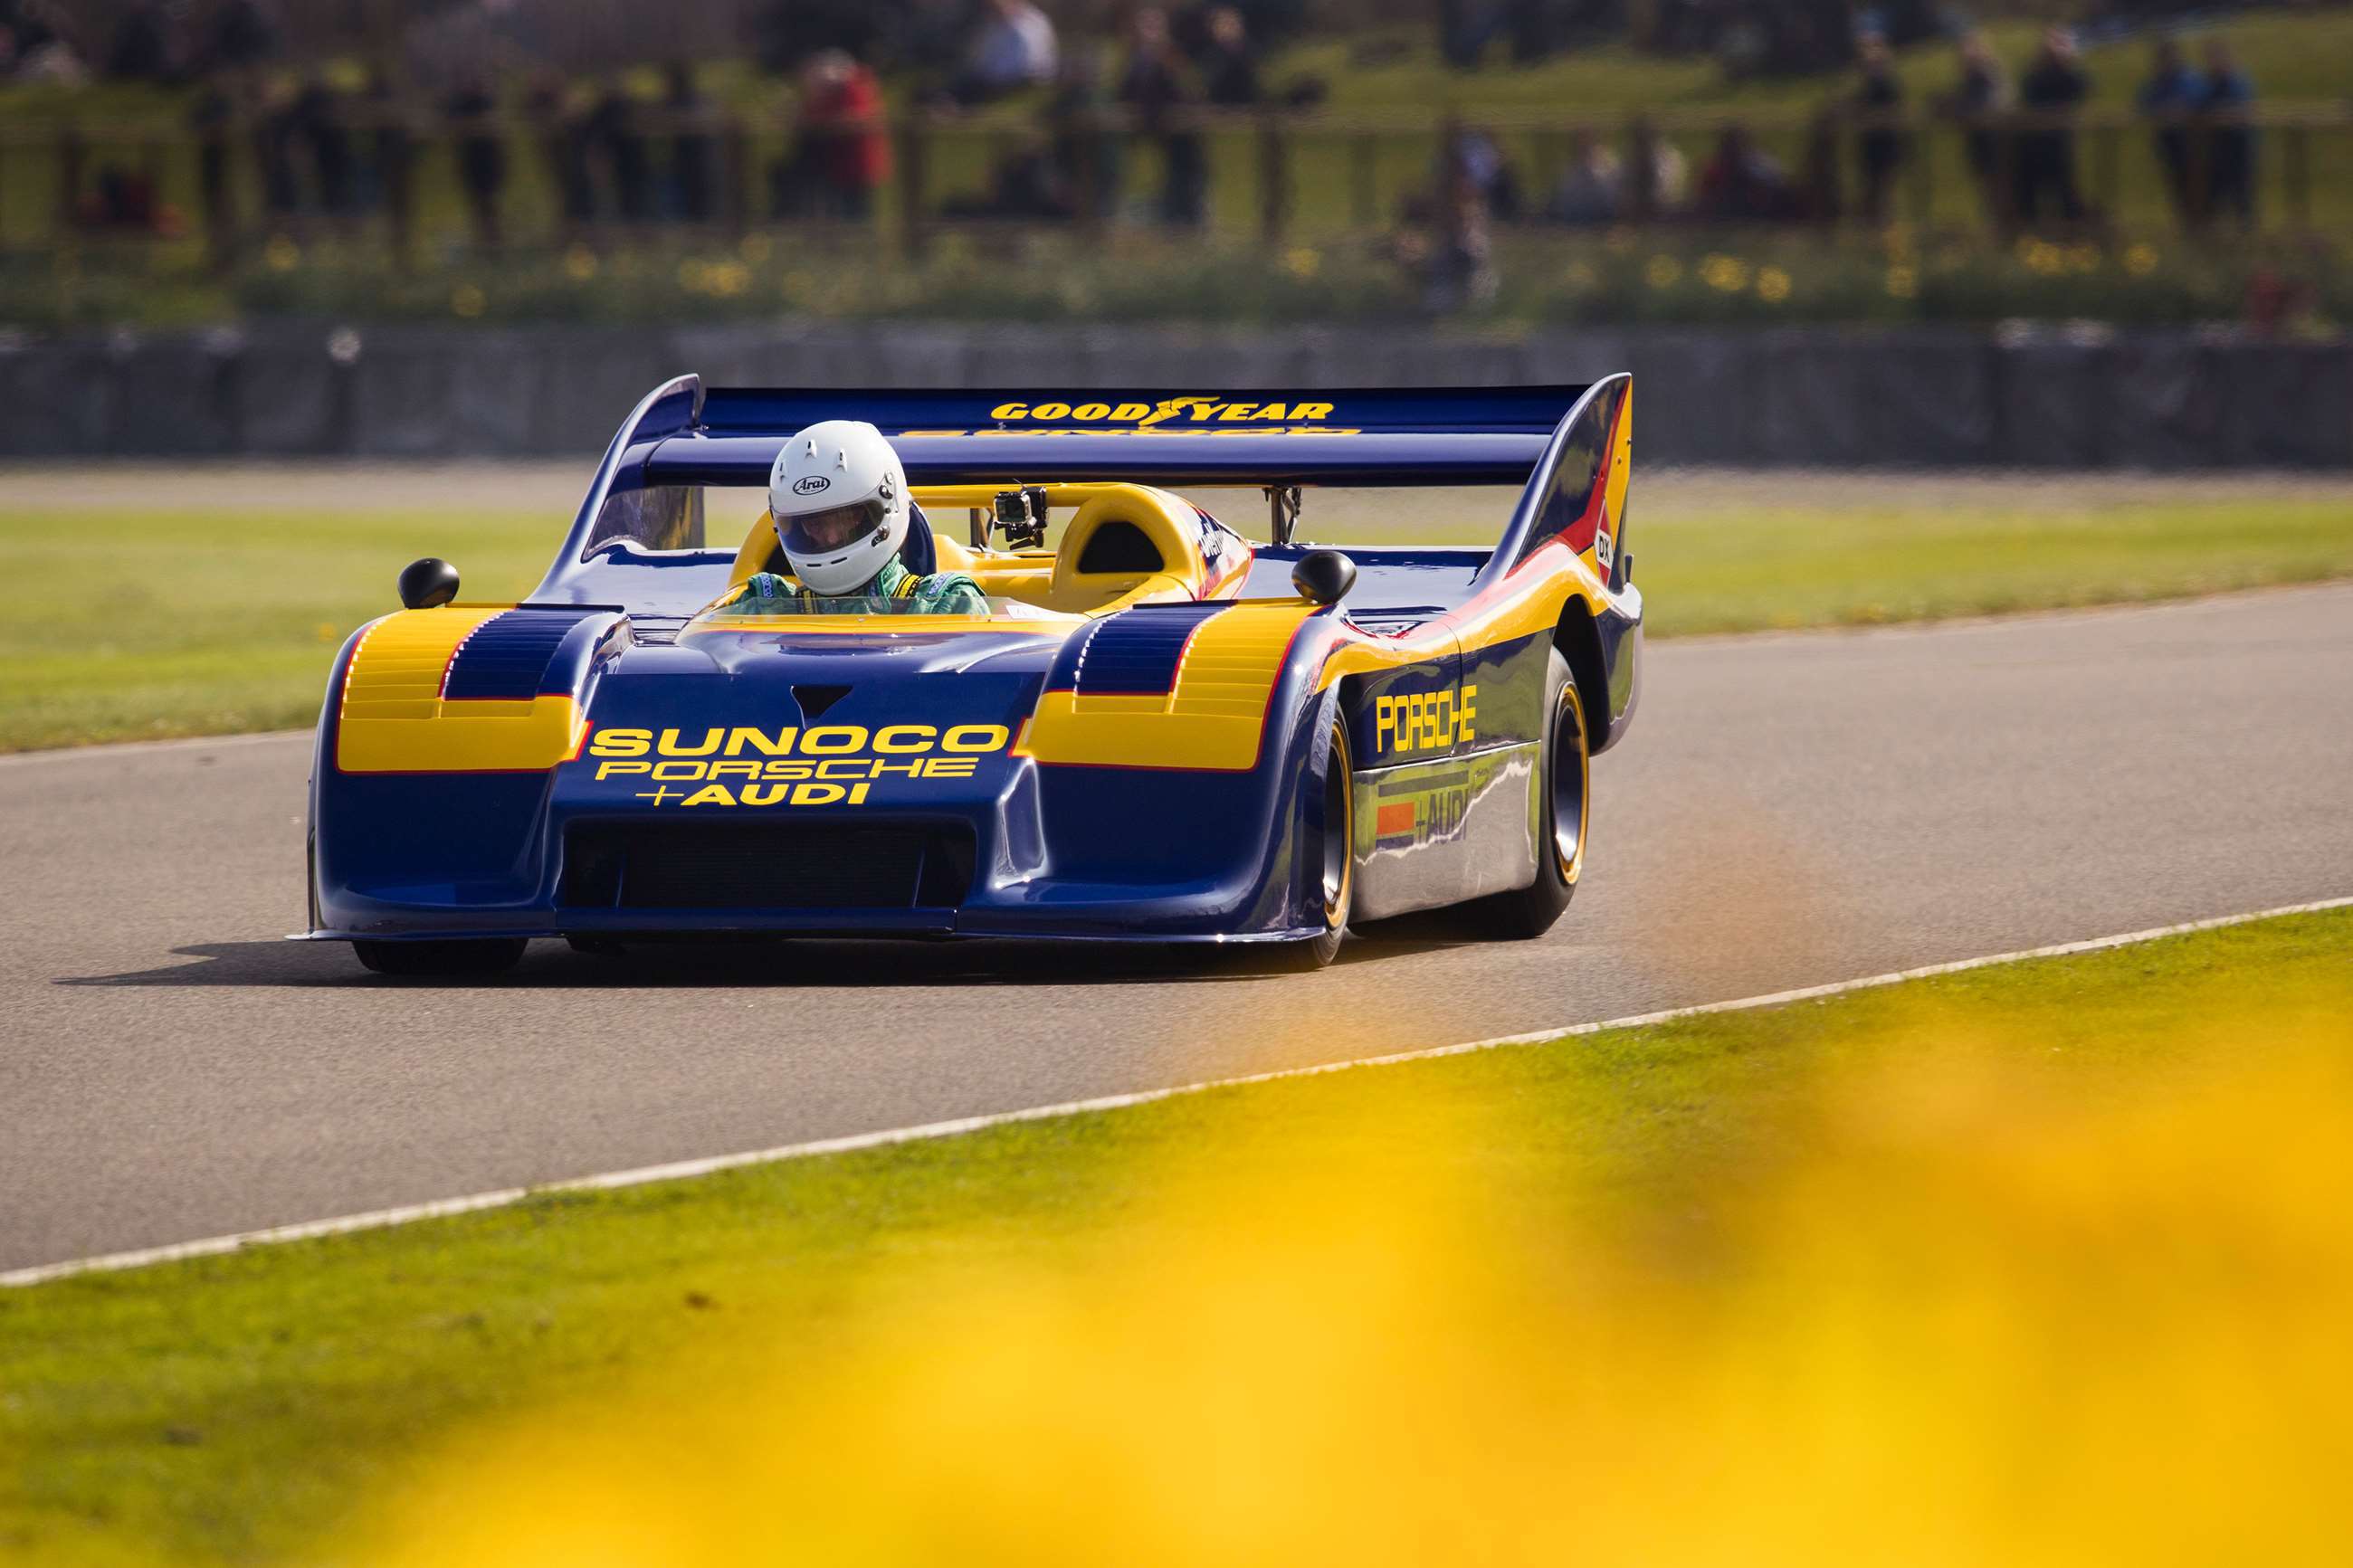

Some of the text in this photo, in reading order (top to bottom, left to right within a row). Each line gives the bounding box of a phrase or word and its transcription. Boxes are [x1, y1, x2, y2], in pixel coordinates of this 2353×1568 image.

[795, 477, 825, 492] Arai
[1598, 534, 1611, 564] DX
[1377, 684, 1477, 753] PORSCHE
[589, 724, 1010, 756] SUNOCO
[595, 757, 980, 781] PORSCHE
